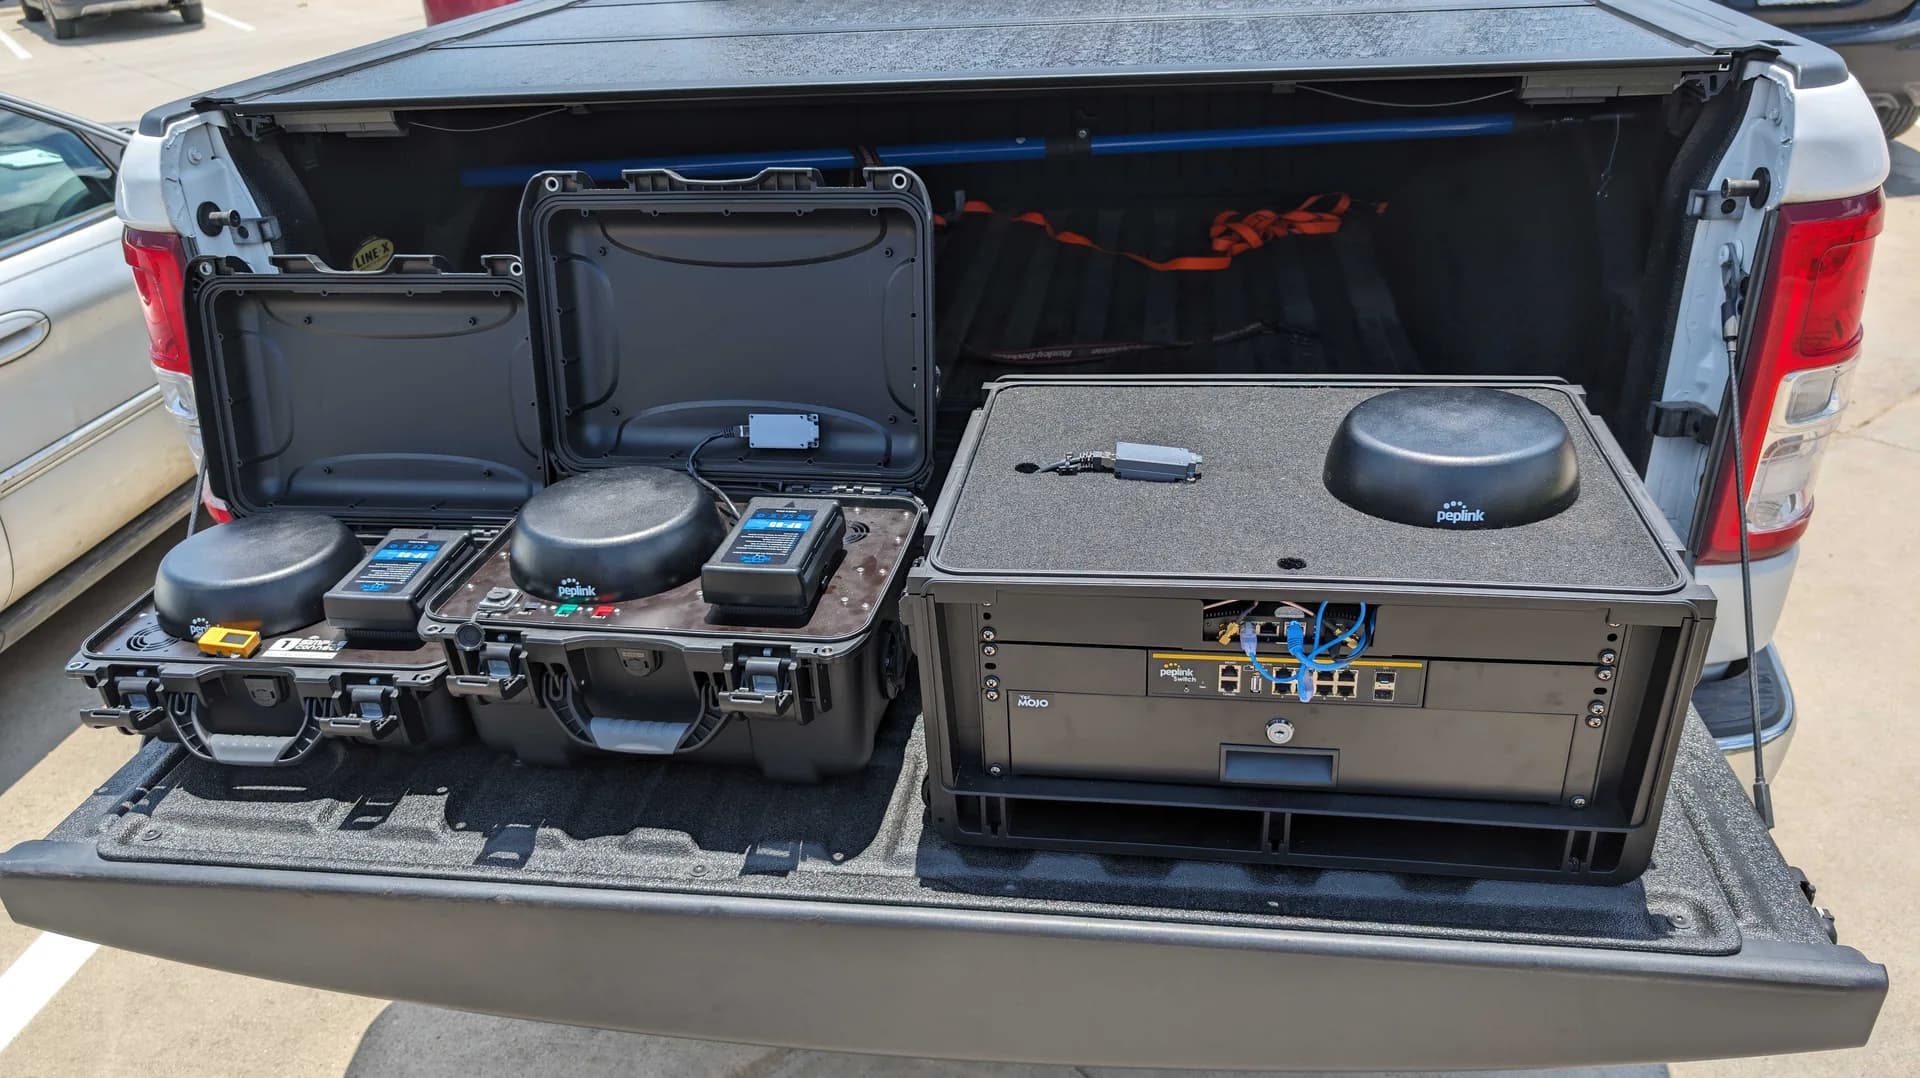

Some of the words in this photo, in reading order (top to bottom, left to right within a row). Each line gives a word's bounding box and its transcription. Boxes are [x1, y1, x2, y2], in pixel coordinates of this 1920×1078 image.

[1437, 509, 1485, 524] peplink
[558, 585, 596, 597] peplink
[1160, 668, 1194, 677] peplink
[1017, 699, 1049, 708] MOJO
